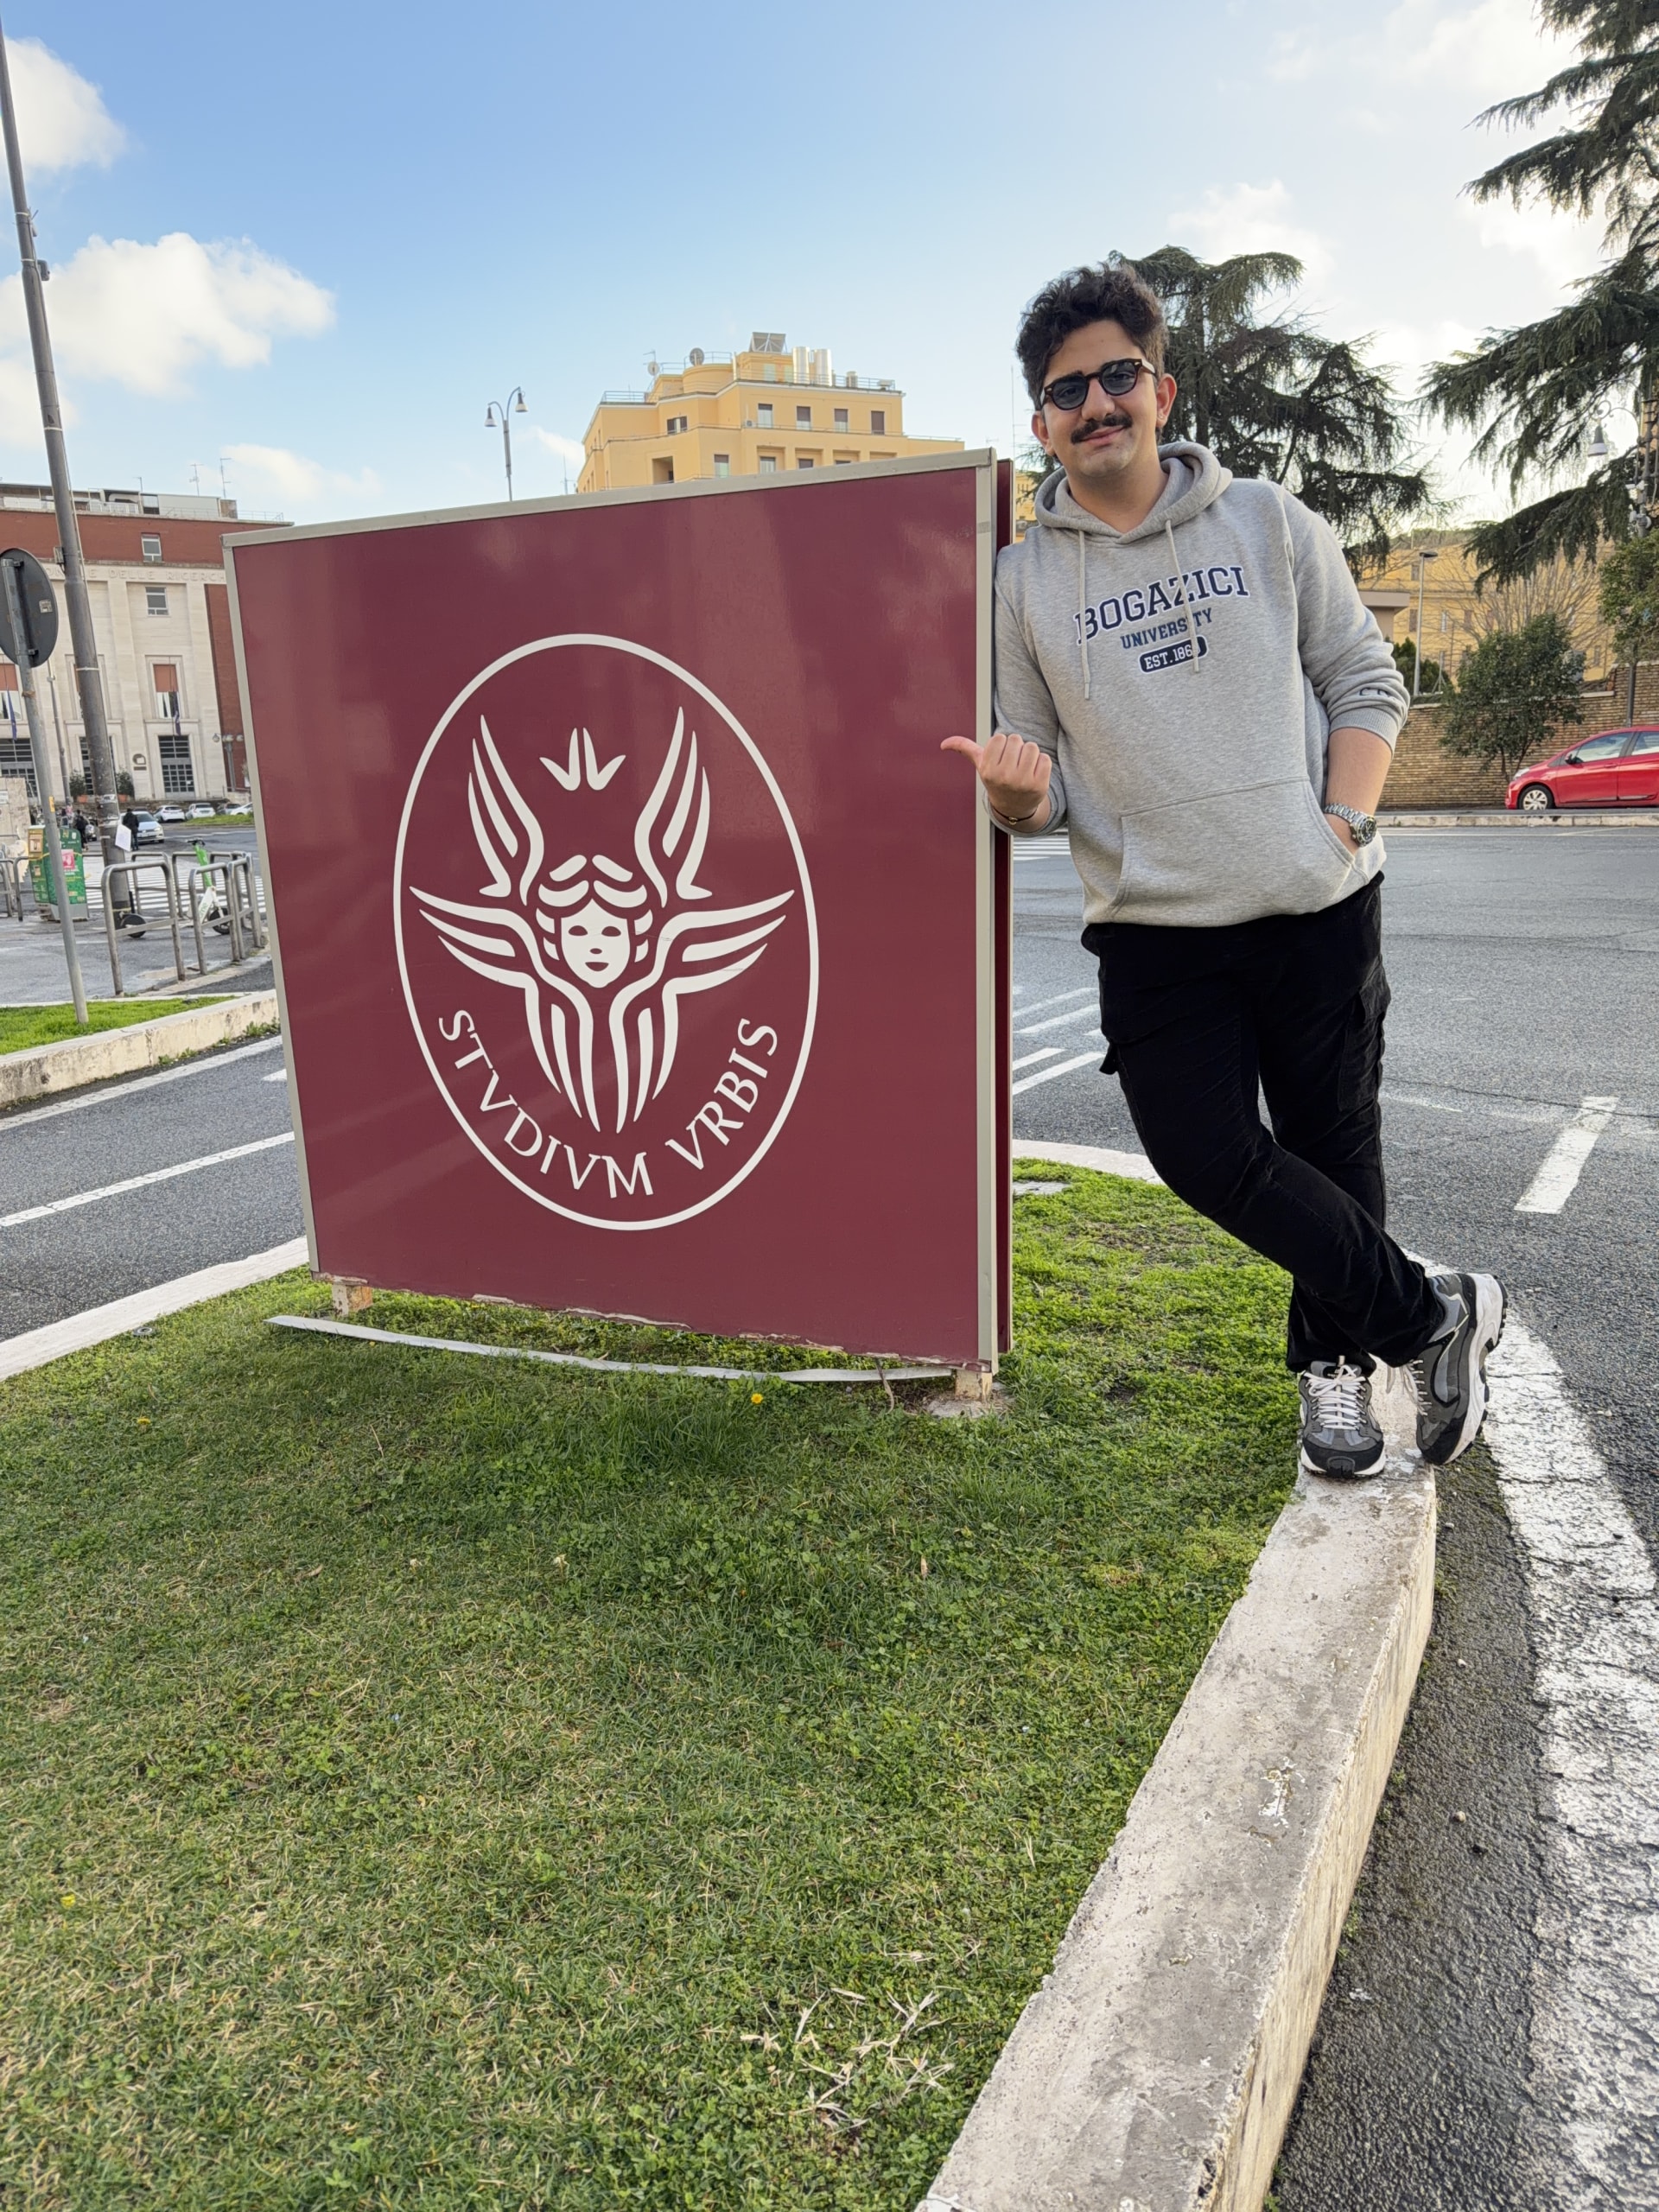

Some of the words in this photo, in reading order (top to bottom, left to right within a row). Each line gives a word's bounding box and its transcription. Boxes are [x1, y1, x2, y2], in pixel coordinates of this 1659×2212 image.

[109, 569, 156, 580] DELLE
[166, 571, 226, 582] RICERCH
[1074, 566, 1249, 645] BOGAZICI
[1120, 607, 1212, 649] UNIVERSTY
[438, 1009, 654, 1198] STVDIVM
[664, 1018, 778, 1171] VRBIS
